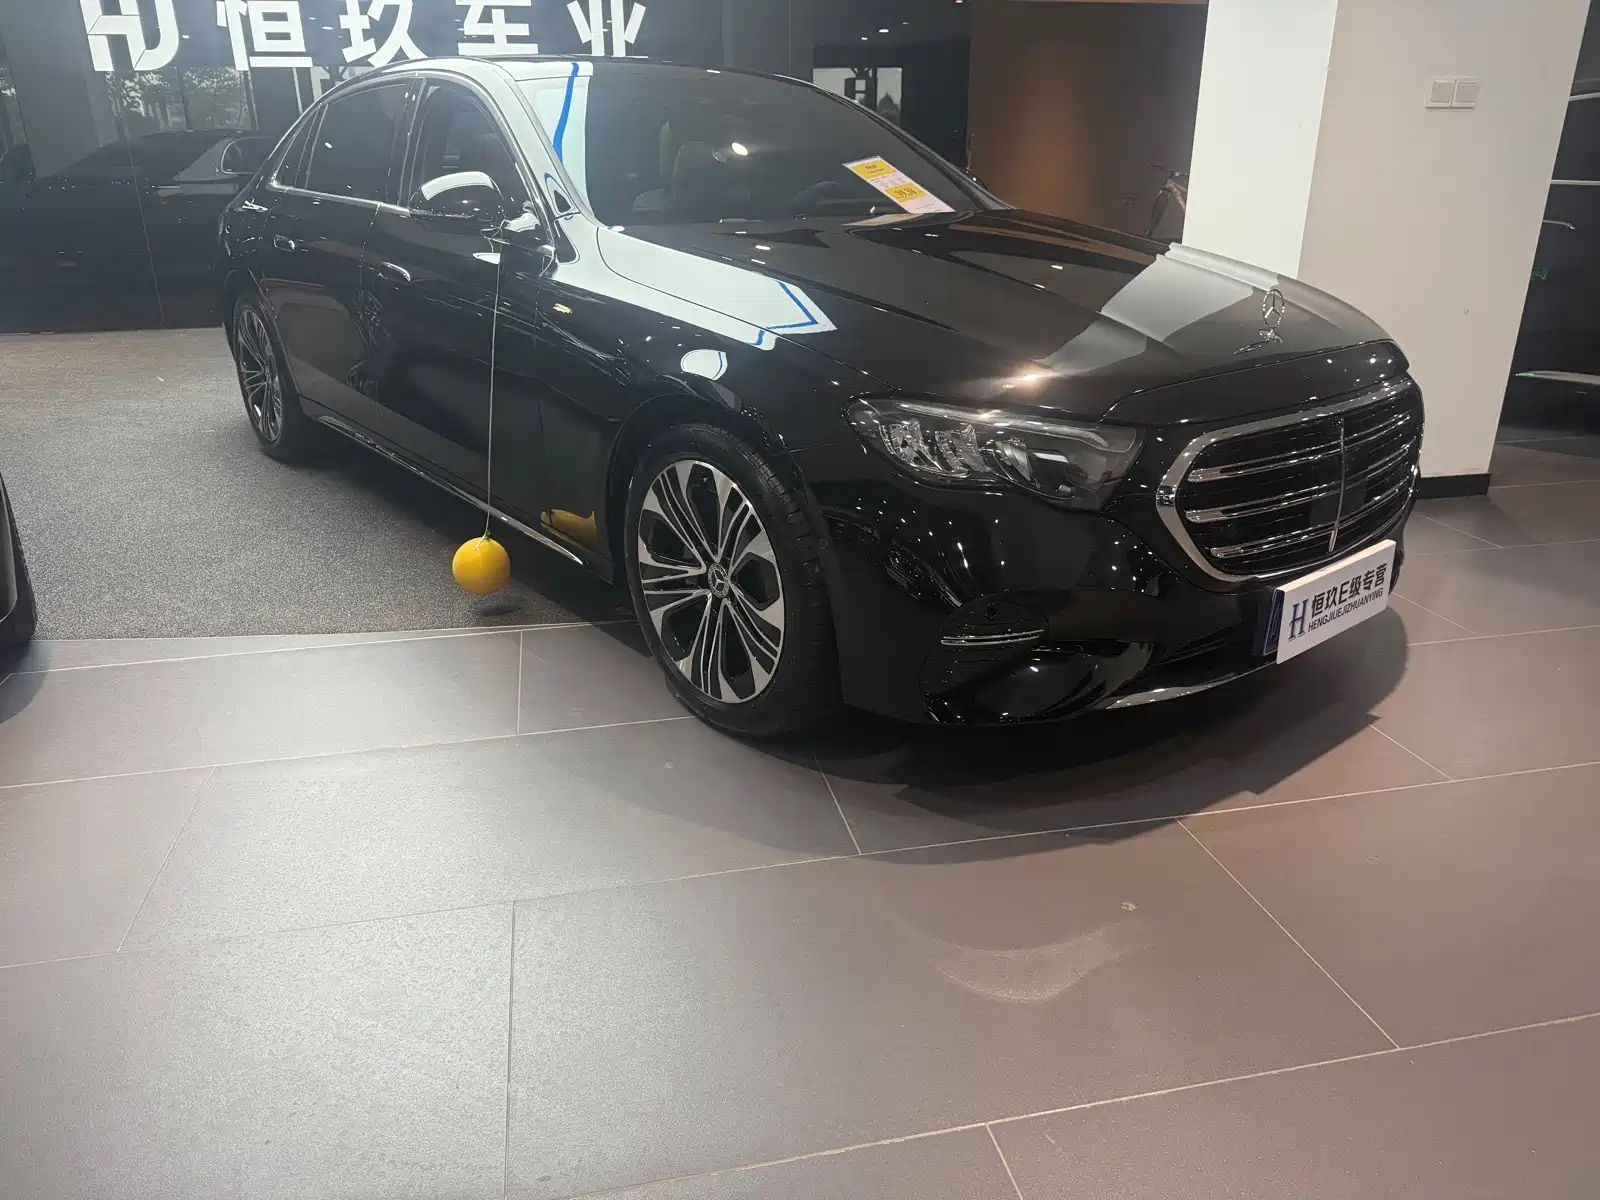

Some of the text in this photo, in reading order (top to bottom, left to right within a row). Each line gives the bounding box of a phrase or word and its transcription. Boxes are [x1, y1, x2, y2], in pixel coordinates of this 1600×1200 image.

[216, 0, 646, 71] 恒玖车业
[1308, 587, 1384, 632] HENGJIUEJIZHUANYING
[1311, 563, 1387, 619] 恒玖E级专营
